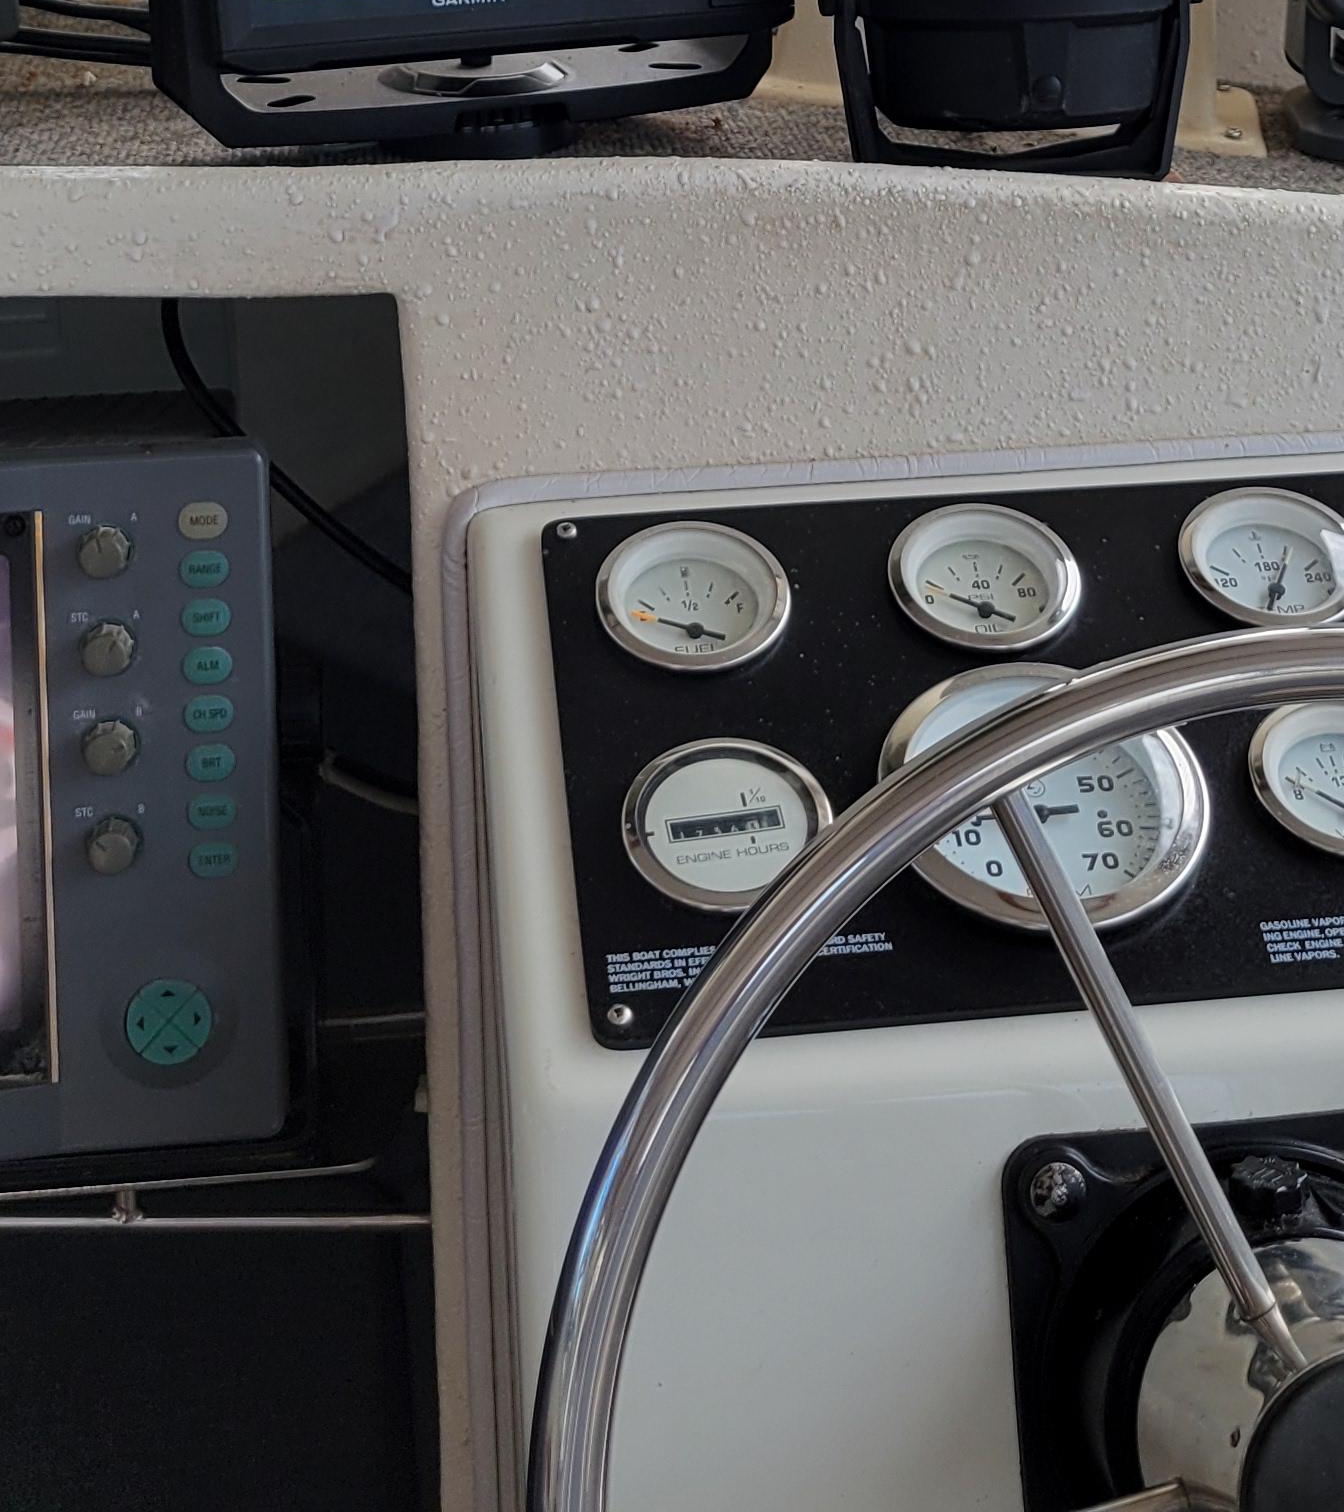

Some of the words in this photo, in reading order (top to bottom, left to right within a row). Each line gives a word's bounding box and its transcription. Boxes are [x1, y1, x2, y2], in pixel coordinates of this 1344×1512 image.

[69, 514, 91, 525] GAIN
[190, 515, 219, 526] MODE
[188, 563, 221, 575] RANGE
[1255, 561, 1280, 572] 180
[1305, 573, 1332, 583] 240
[972, 579, 990, 590] 40
[1017, 587, 1036, 598] 80
[682, 600, 699, 612] 1/2
[71, 613, 89, 623] STC
[192, 612, 220, 623] SHIFT
[975, 623, 1004, 634] OIL
[197, 660, 220, 671] ALM
[1076, 775, 1114, 793] 50
[75, 807, 94, 817] STC
[1097, 819, 1133, 838] 60
[952, 829, 981, 847] 10
[676, 849, 731, 865] ENGINE
[737, 842, 789, 857] HOURS
[1082, 852, 1119, 872] 70
[985, 860, 1003, 877] 0
[1260, 919, 1312, 931] GASOLINE
[1263, 931, 1282, 942] ING
[1283, 928, 1325, 941] ENGINE,
[606, 953, 630, 963] THIS
[632, 950, 660, 961] BOAT
[663, 945, 717, 959] COMPLIES
[848, 932, 886, 944] SAFETY
[1266, 941, 1302, 953] CHECK
[1305, 937, 1344, 950] ENGINE
[607, 959, 672, 973] STANDARDS
[817, 941, 893, 956] CERTIFICATION
[1269, 952, 1294, 964] LINE
[1294, 948, 1340, 962] VAPORS.
[608, 969, 651, 983] WRIGHT
[654, 967, 686, 979] BROS.
[610, 979, 681, 993] BELLINGHAM,
